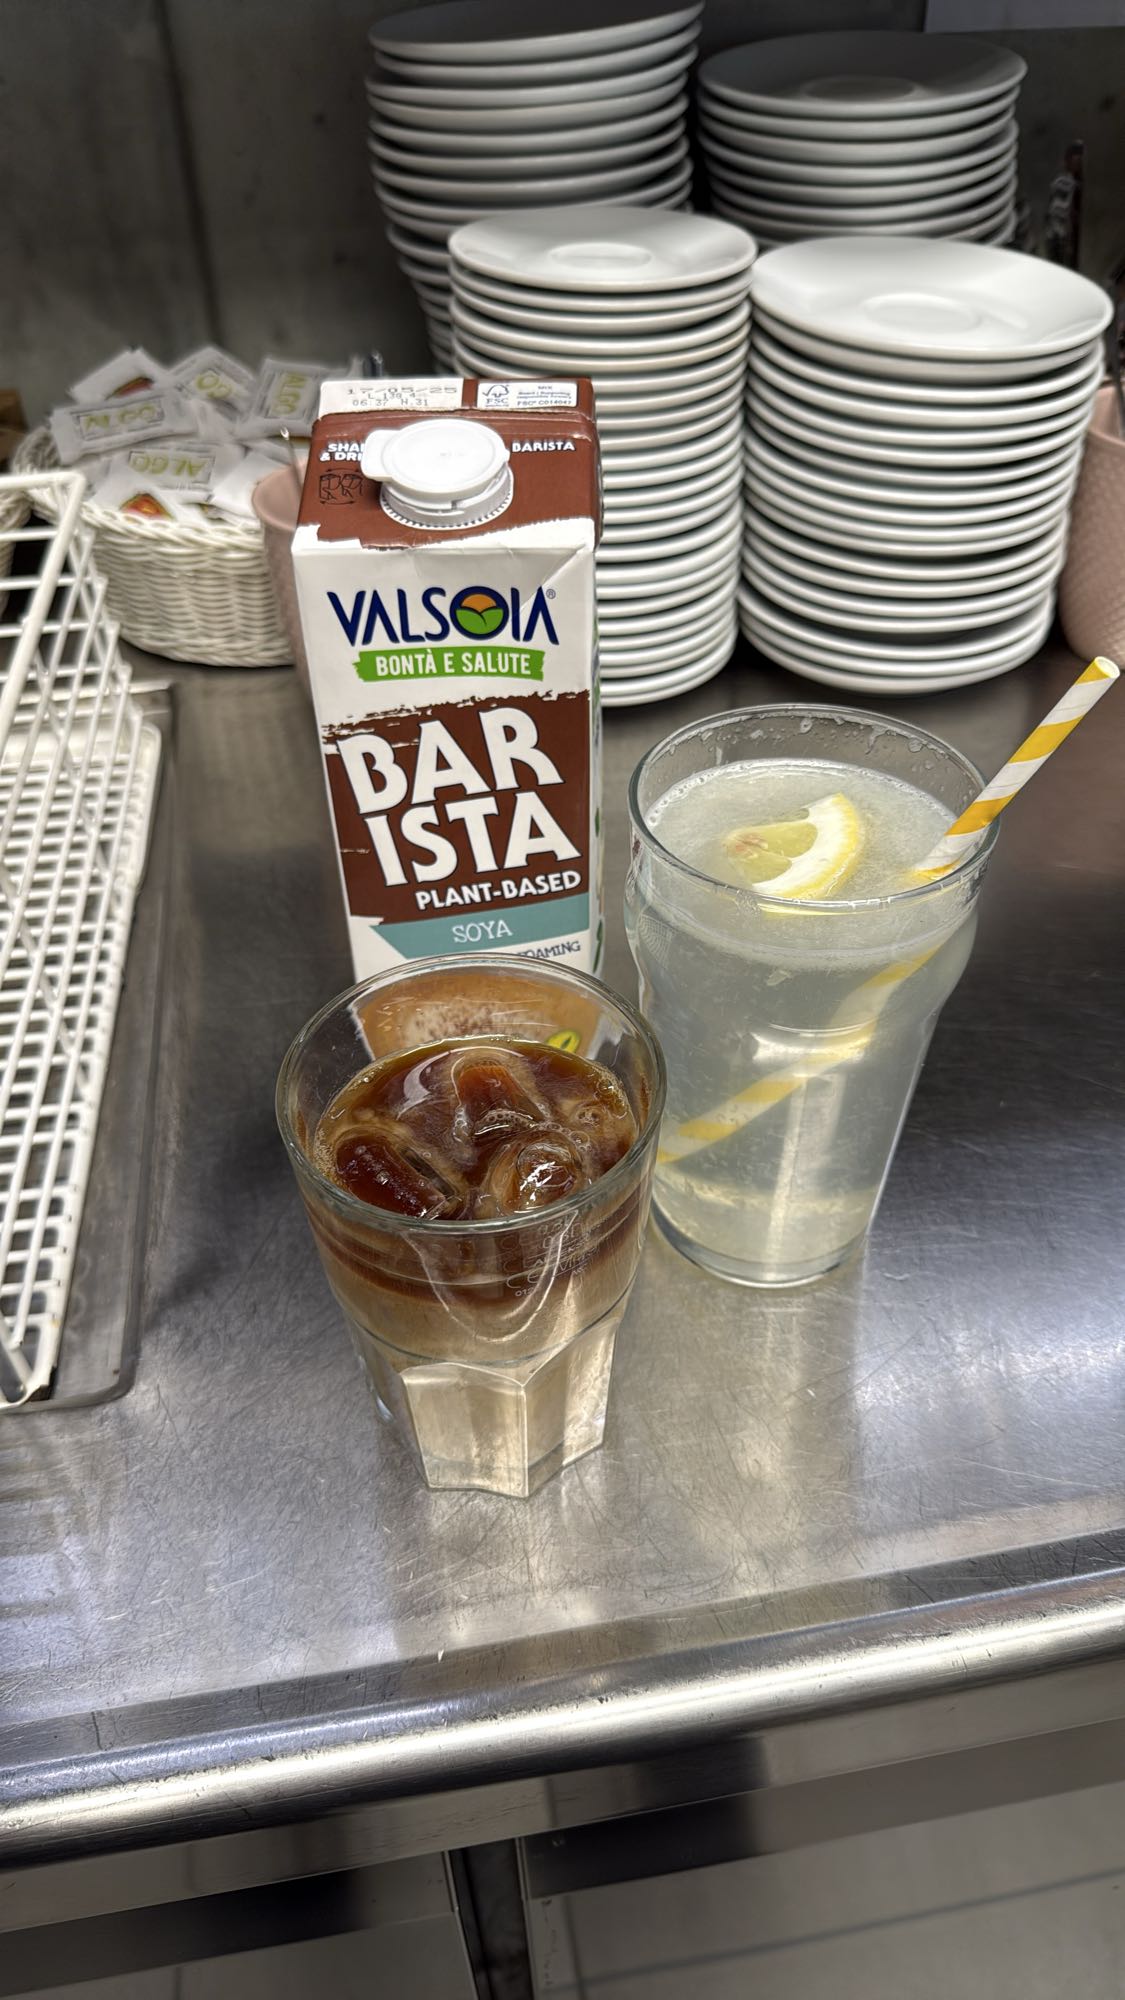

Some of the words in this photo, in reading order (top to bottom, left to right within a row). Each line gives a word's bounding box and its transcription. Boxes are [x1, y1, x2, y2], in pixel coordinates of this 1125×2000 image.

[346, 386, 457, 394] 17/05/25
[319, 452, 331, 461] &
[511, 441, 575, 453] BARISTA
[375, 649, 438, 677] BONTÀ
[443, 653, 454, 674] E
[461, 652, 532, 675] SALUTE
[336, 707, 564, 815] BAR
[364, 791, 582, 887] ISTA
[415, 870, 582, 910] PLANT-BASED
[452, 920, 513, 943] SOYA
[518, 940, 581, 958] OAMING
